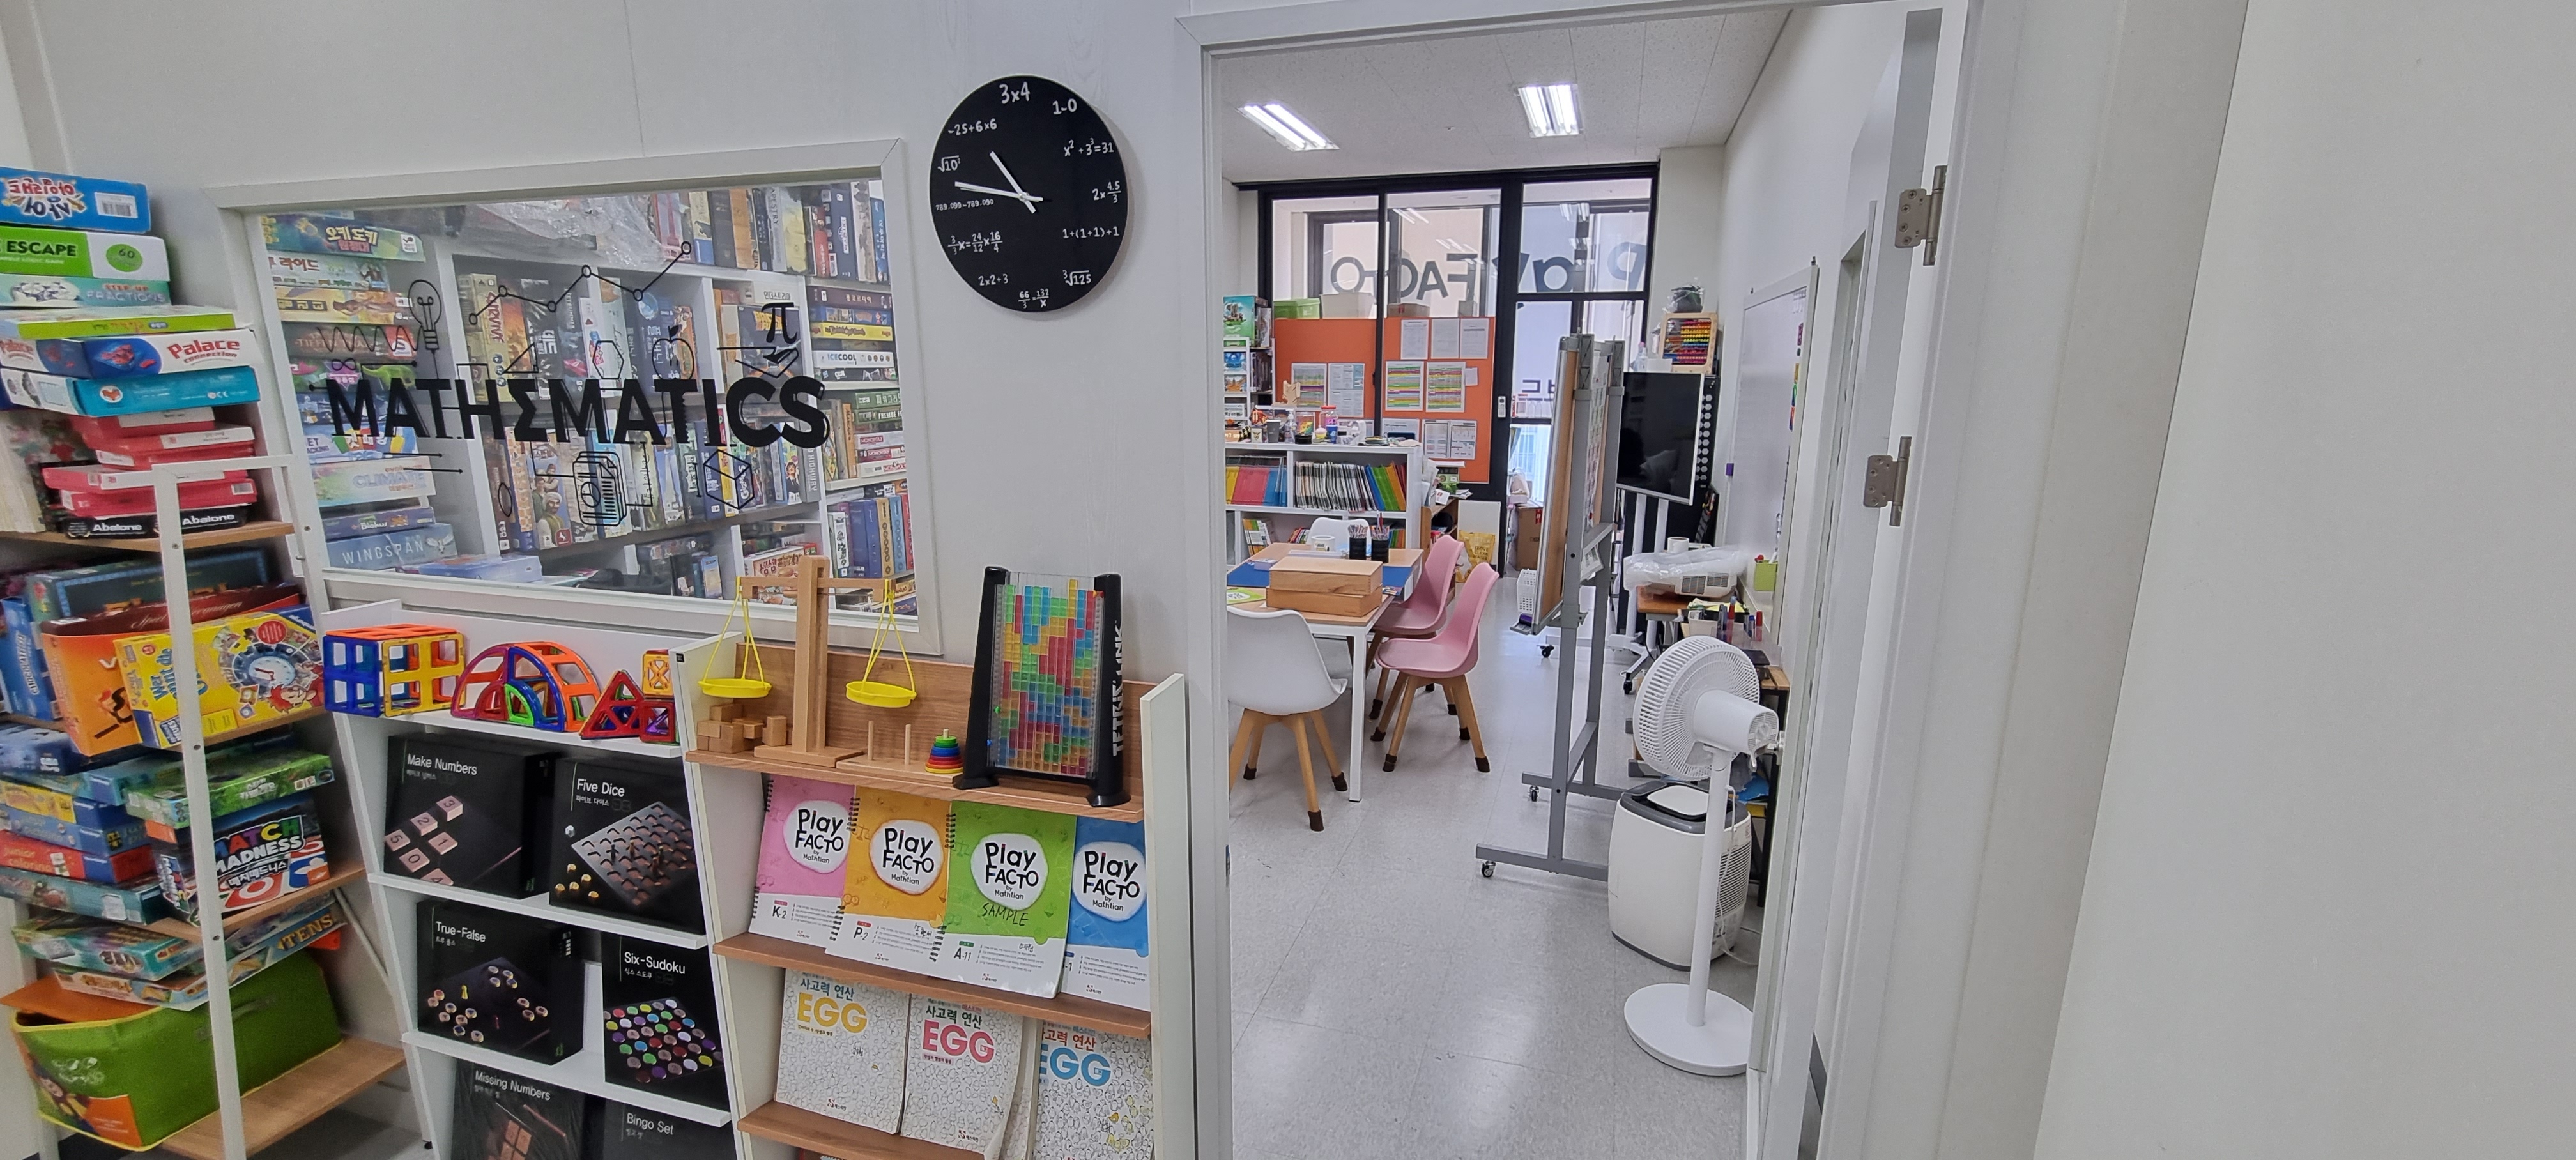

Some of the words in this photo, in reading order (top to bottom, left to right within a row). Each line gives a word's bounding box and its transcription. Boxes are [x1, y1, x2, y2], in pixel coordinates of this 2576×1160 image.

[24, 196, 72, 220] 상어
[7, 240, 76, 256] ESCAPE
[118, 247, 135, 259] 60
[280, 257, 320, 271] 라이드
[167, 340, 240, 359] Palace
[184, 353, 237, 363] connection
[93, 523, 142, 532] Abalone
[183, 514, 234, 525] Abalone
[360, 521, 387, 530] Blokus
[342, 541, 424, 565] WINGSPAN
[150, 675, 169, 701] Wer
[408, 753, 432, 768] Make
[434, 758, 477, 775] Numbers
[577, 777, 598, 793] Five
[601, 782, 625, 797] Dice
[576, 795, 592, 804] 파이브
[594, 798, 610, 806] 다이스
[798, 809, 843, 837] Play
[795, 830, 843, 853] FACTO
[884, 828, 933, 859] Play
[216, 836, 302, 873] MADNESS
[803, 854, 830, 864] Mathtian
[882, 850, 935, 874] FACTO
[985, 842, 1036, 871] Play
[1084, 850, 1138, 882] Play
[891, 874, 919, 885] Mathtian
[985, 864, 1039, 889] FACTO
[1083, 873, 1140, 900] FACTO
[995, 889, 1024, 900] Mathtian
[1092, 899, 1124, 912] Mathtian
[772, 905, 787, 919] K-2
[982, 903, 1028, 926] SAMPLE
[436, 920, 486, 943] True-False
[854, 927, 869, 941] P-2
[624, 951, 686, 975] Six-Sudoku
[953, 948, 972, 961] A-11
[636, 970, 652, 979] 스도쿠
[800, 978, 830, 996] 사고력
[834, 984, 855, 1002] 연산
[797, 992, 868, 1034] EGG
[925, 1005, 958, 1023] 사고력
[961, 1012, 983, 1030] 연산
[922, 1019, 995, 1063] EGG
[1073, 1034, 1096, 1052] 연산
[475, 1071, 507, 1090] Missing
[510, 1080, 551, 1101] Numbers
[627, 1113, 654, 1131] Bingo
[657, 1122, 674, 1136] Set
